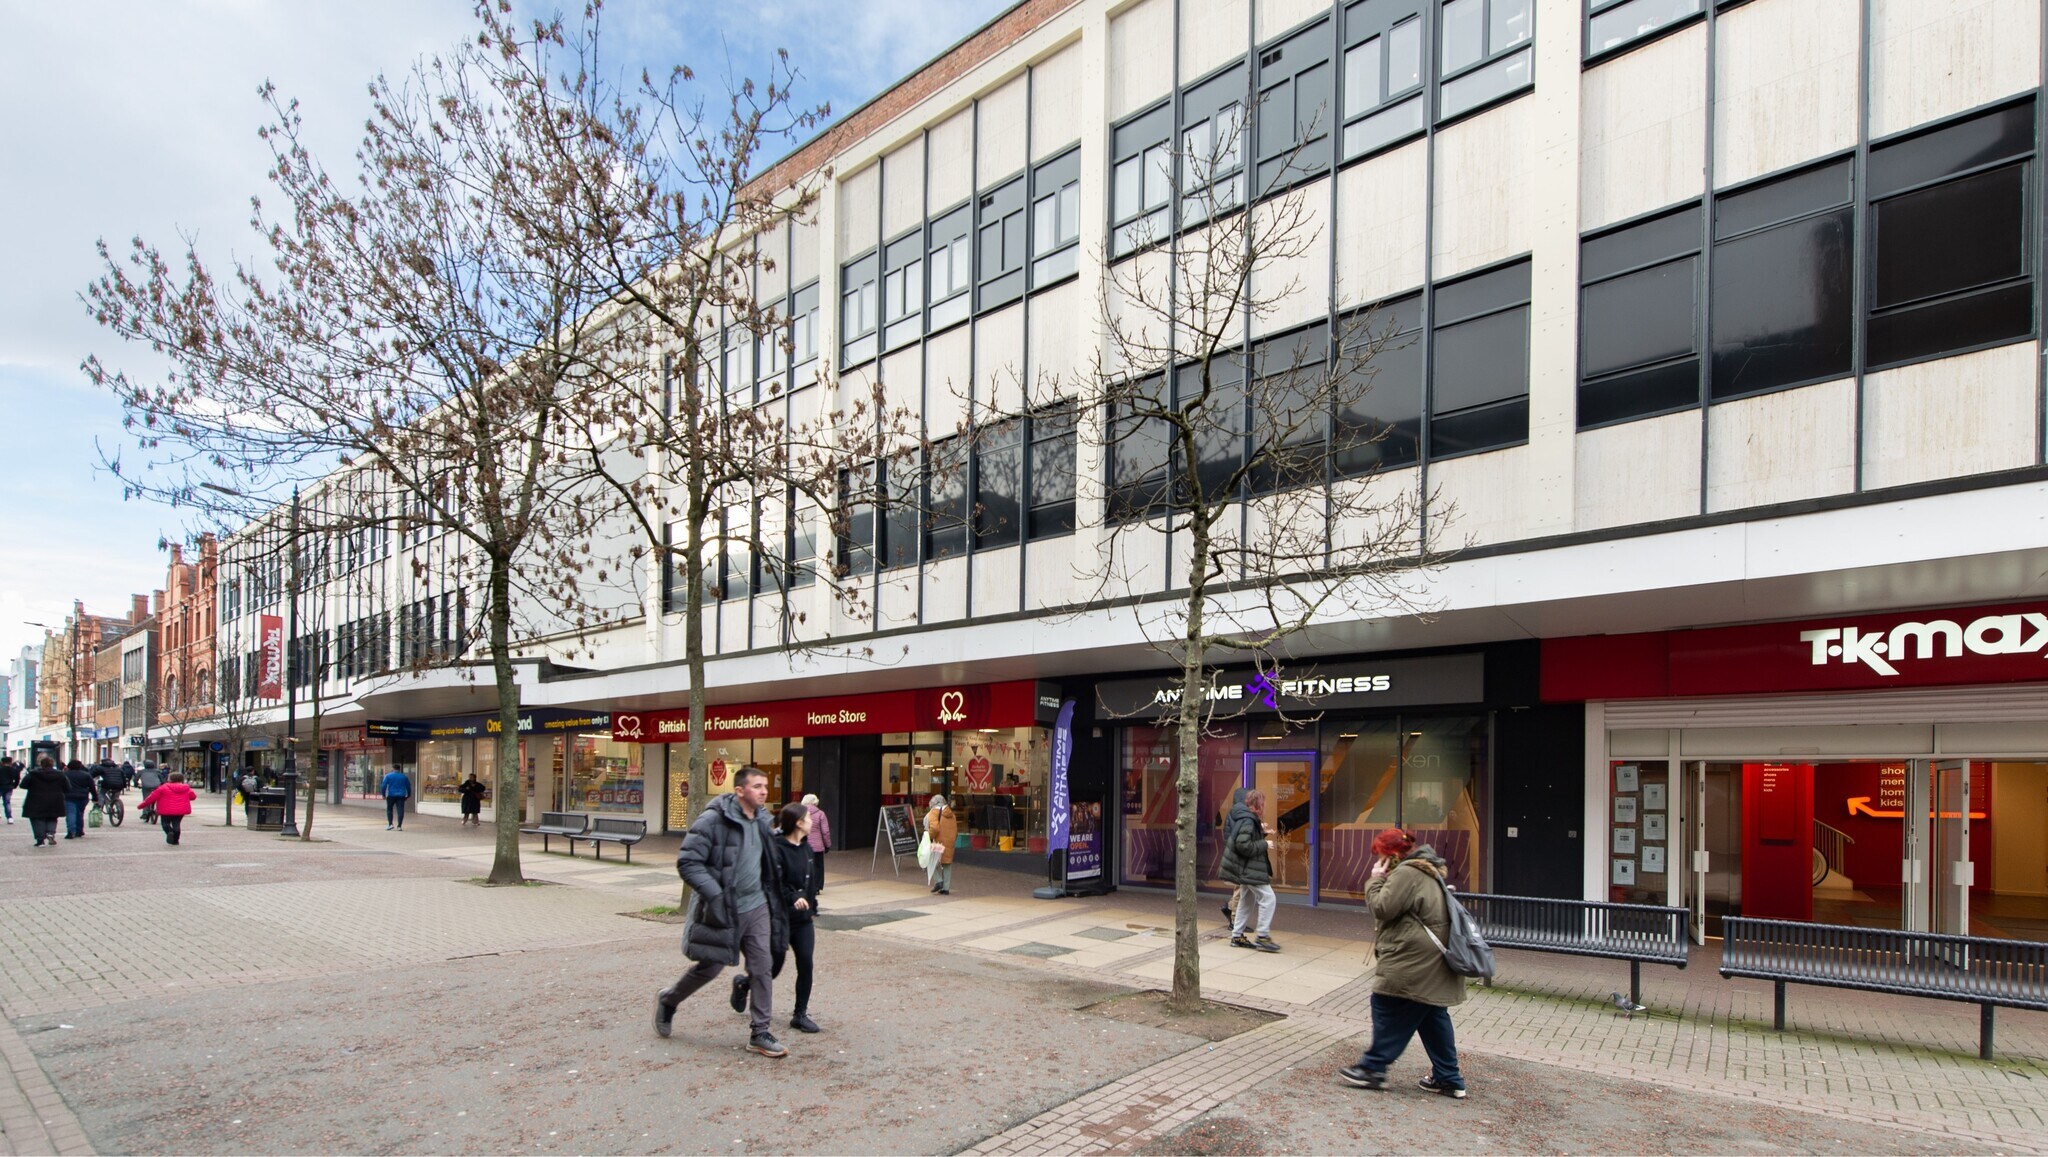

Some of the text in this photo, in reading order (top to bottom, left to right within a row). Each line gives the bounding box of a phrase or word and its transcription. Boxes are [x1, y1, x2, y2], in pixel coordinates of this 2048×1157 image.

[1154, 674, 1391, 704] ANIME FITNESS
[591, 716, 603, 726] only
[807, 709, 867, 725] Home Store
[486, 715, 533, 733] Oneond
[658, 720, 687, 734] British
[713, 714, 769, 731] Foundation
[1881, 788, 1905, 796] hom
[1881, 798, 1904, 807] kids
[1069, 833, 1094, 843] WE ARE
